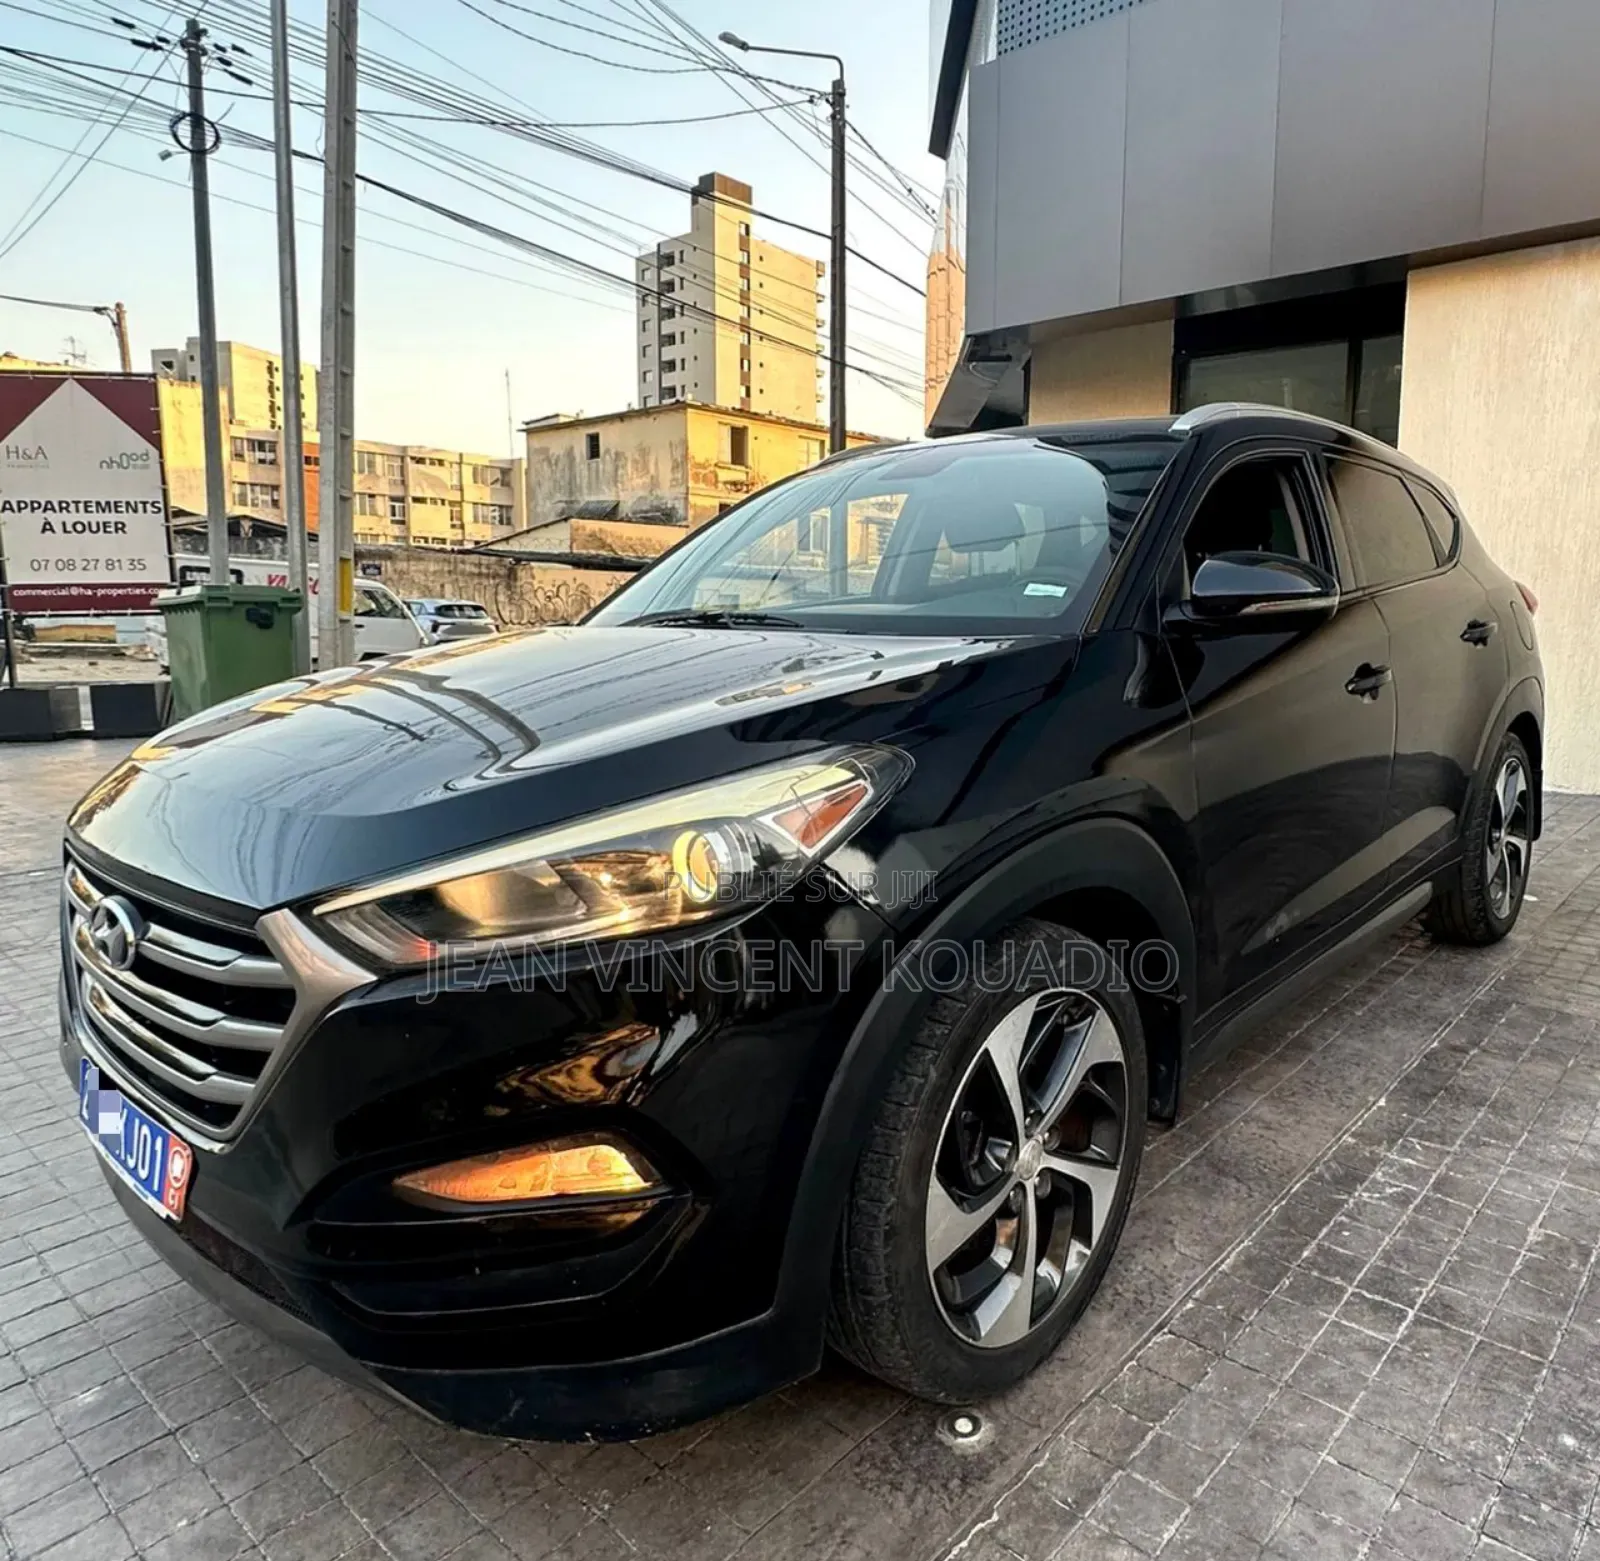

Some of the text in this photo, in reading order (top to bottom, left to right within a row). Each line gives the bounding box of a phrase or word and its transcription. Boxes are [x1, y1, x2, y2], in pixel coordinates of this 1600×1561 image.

[6, 445, 48, 461] H&A
[1, 500, 162, 514] APPARTEMENTS
[40, 517, 127, 535] À LOUER
[30, 558, 147, 572] 07 08 27 81 35
[13, 586, 160, 597] commercial@ha-properties.co
